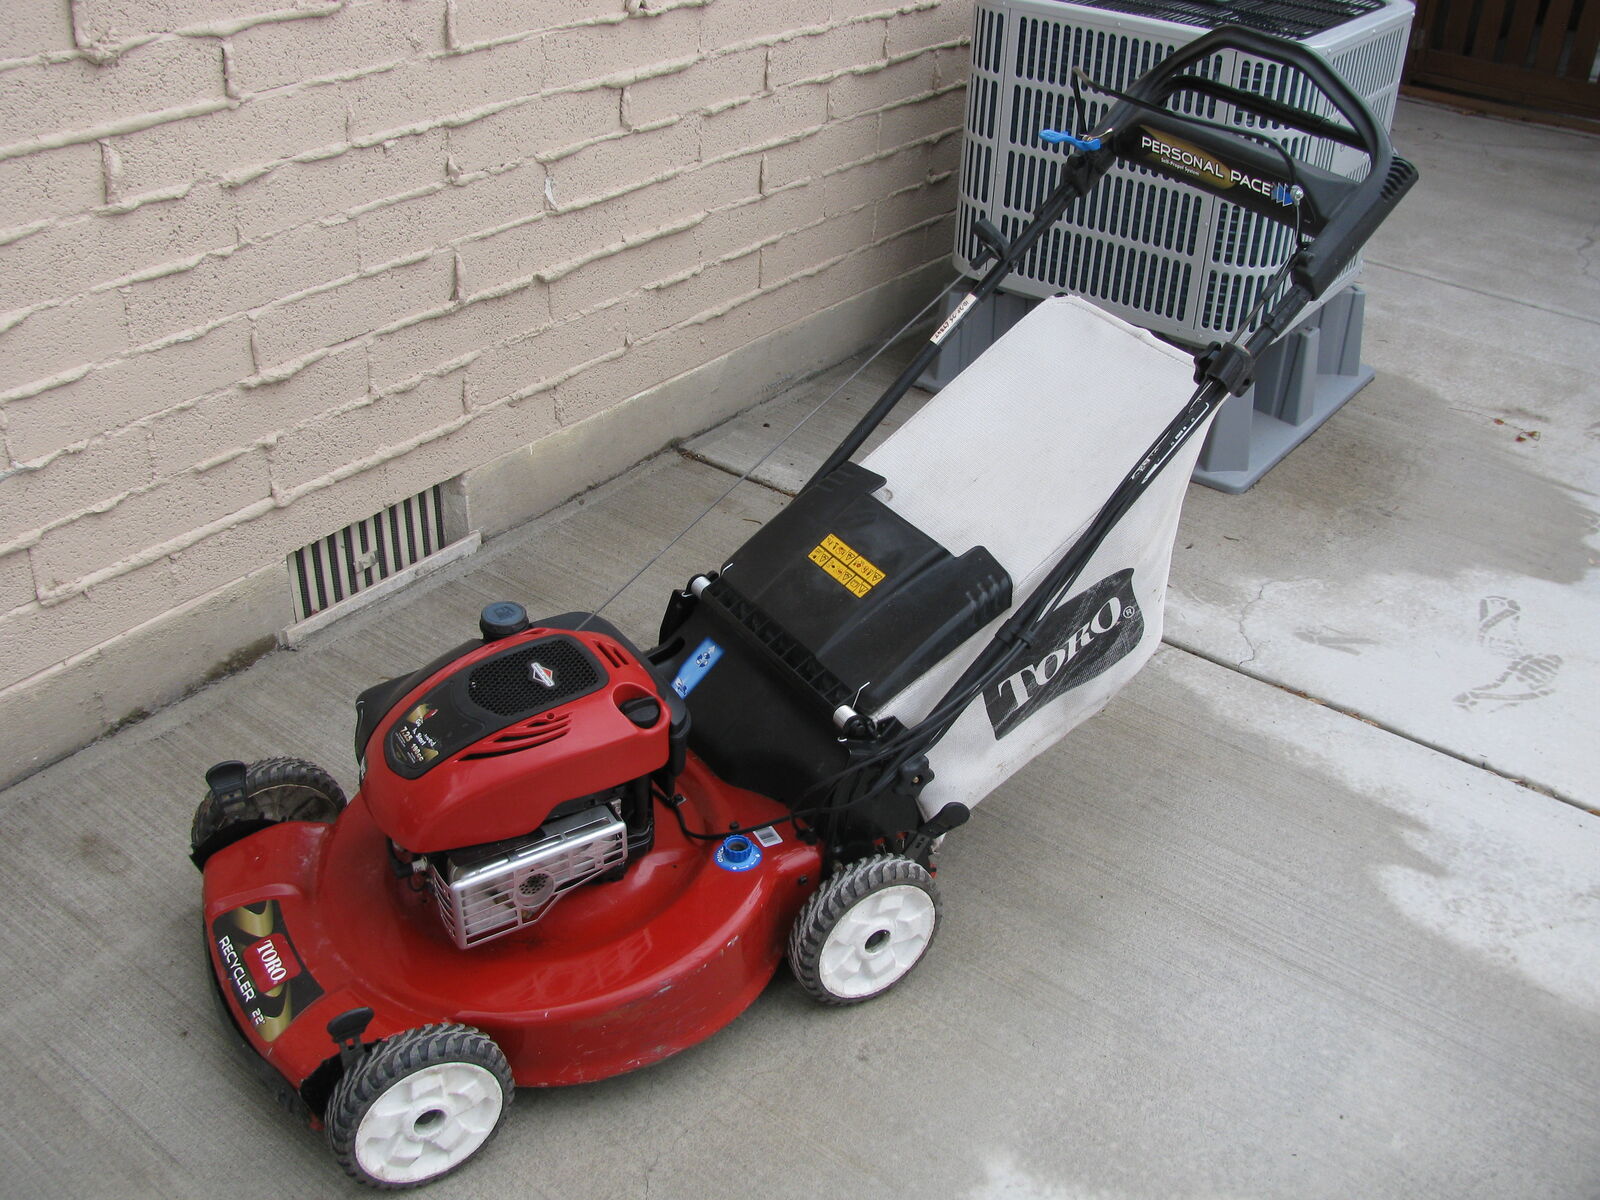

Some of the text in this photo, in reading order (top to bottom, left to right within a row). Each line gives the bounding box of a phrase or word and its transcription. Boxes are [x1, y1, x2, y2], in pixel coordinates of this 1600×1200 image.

[1141, 136, 1272, 196] PERSONAL PACE
[998, 596, 1122, 709] TORO
[218, 935, 255, 1003] RECYCLER
[257, 939, 287, 981] TORO
